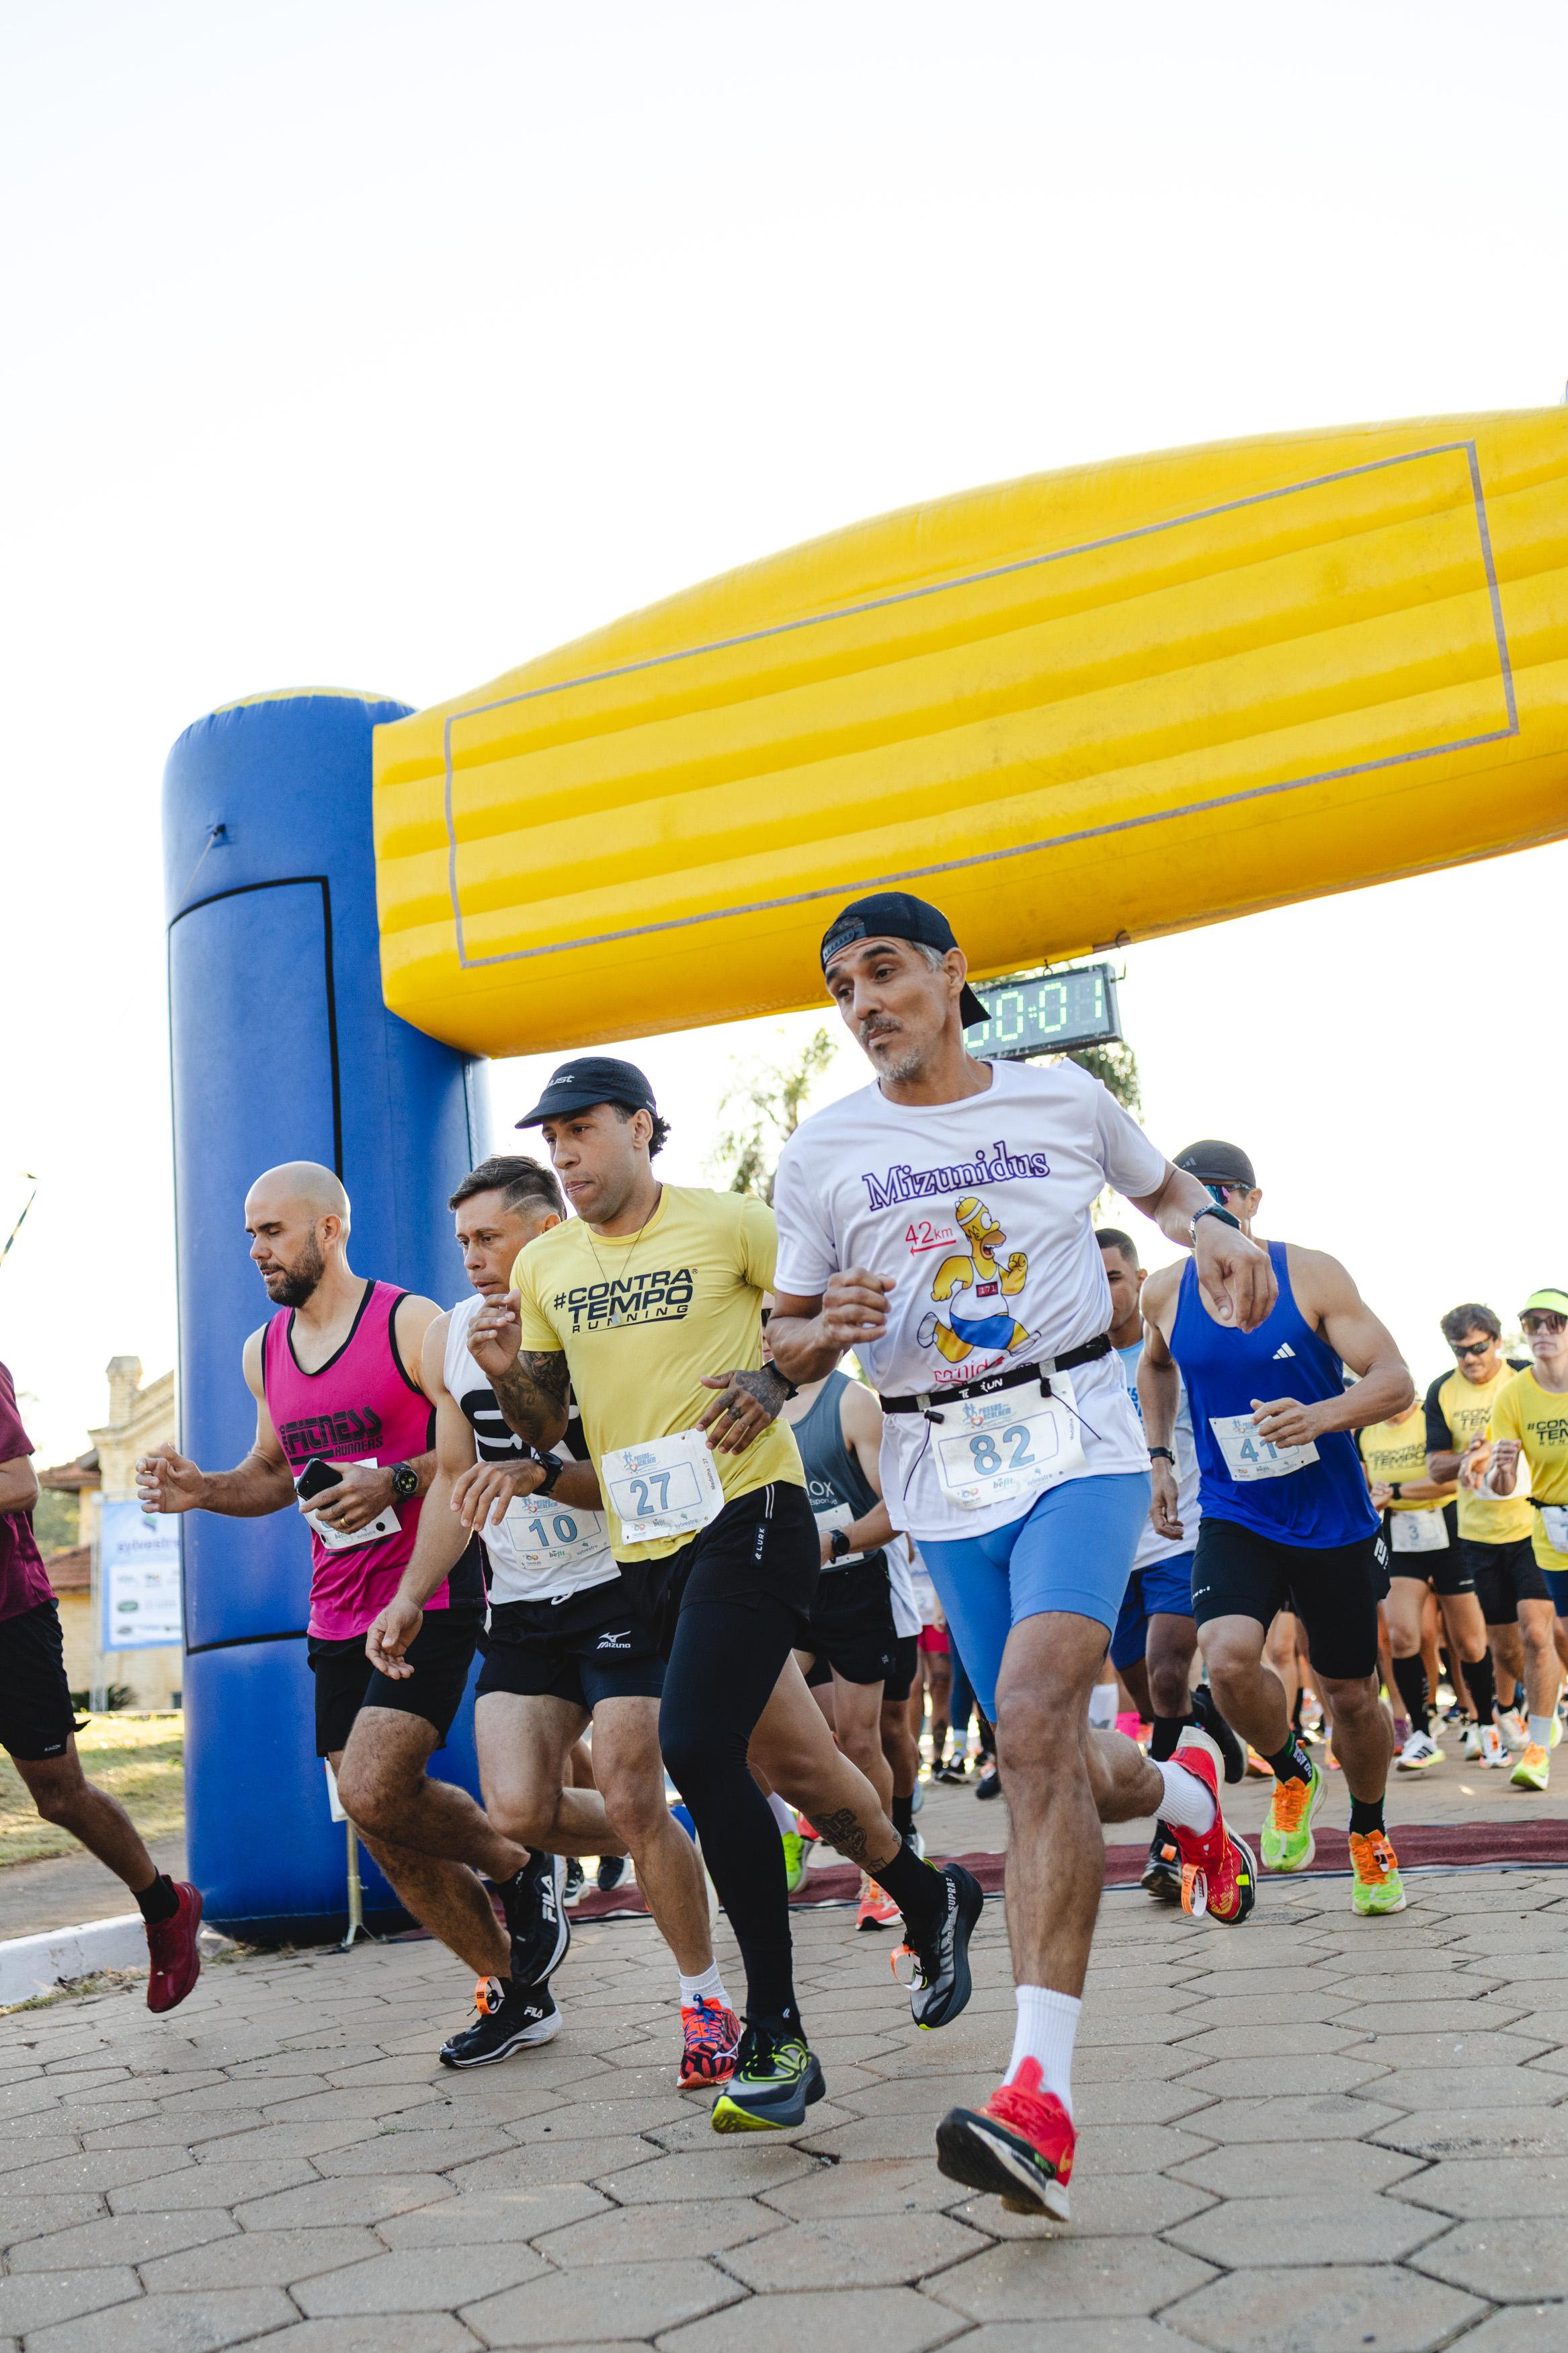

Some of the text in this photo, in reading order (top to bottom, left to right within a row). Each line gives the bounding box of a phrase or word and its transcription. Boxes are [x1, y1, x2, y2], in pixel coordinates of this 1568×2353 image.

[862, 1140, 1050, 1211] Mizunidus
[569, 1285, 693, 1324] TEMPO
[980, 1285, 997, 1294] 171
[335, 1436, 384, 1458] RUNNERS
[969, 1425, 1035, 1475] 82
[630, 1472, 671, 1515] 27
[529, 1515, 577, 1547] 10
[756, 1527, 765, 1552] LURK
[541, 1875, 557, 1923] FILA
[524, 2006, 543, 2018] FILA
